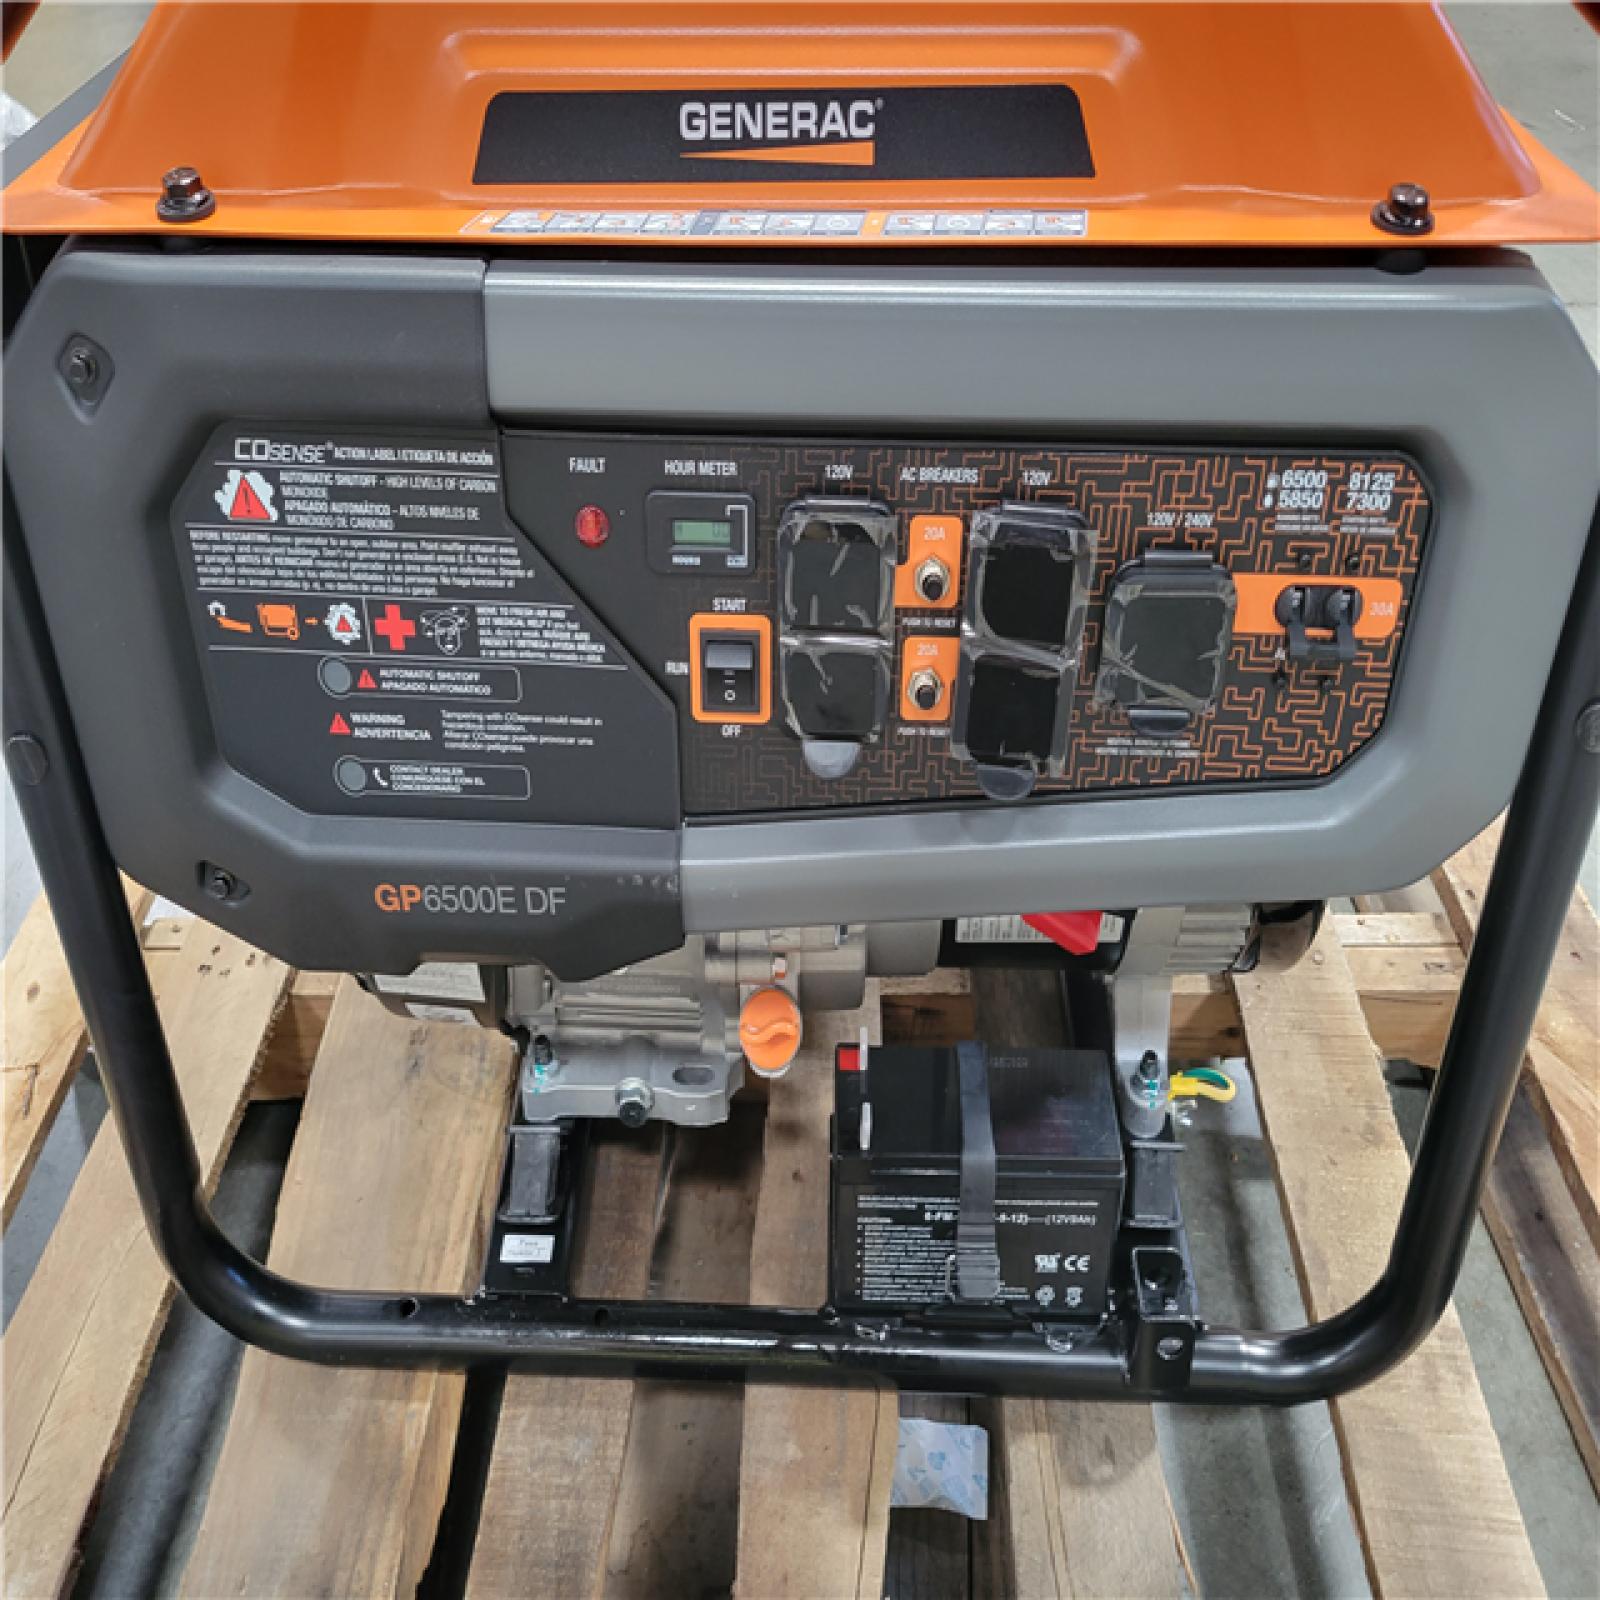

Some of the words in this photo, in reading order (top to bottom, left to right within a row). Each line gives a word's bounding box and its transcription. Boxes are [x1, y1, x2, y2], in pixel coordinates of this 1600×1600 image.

[680, 101, 875, 141] GENERAC
[569, 456, 606, 473] FAULT
[664, 459, 696, 475] HOUR
[699, 460, 738, 476] METER
[825, 465, 853, 480] 120V
[900, 467, 917, 481] AC
[919, 467, 979, 483] BREAKERS
[1023, 470, 1051, 485] 120V
[1281, 470, 1327, 488] 6500
[1349, 472, 1396, 491] 8125
[1346, 491, 1392, 511] 7300
[924, 526, 945, 541] 20A
[712, 597, 746, 612] START
[664, 660, 688, 675] RUN
[350, 712, 406, 726] WARNING
[721, 724, 741, 737] OFF
[374, 884, 518, 913] GP6500E
[525, 886, 567, 915] DF
